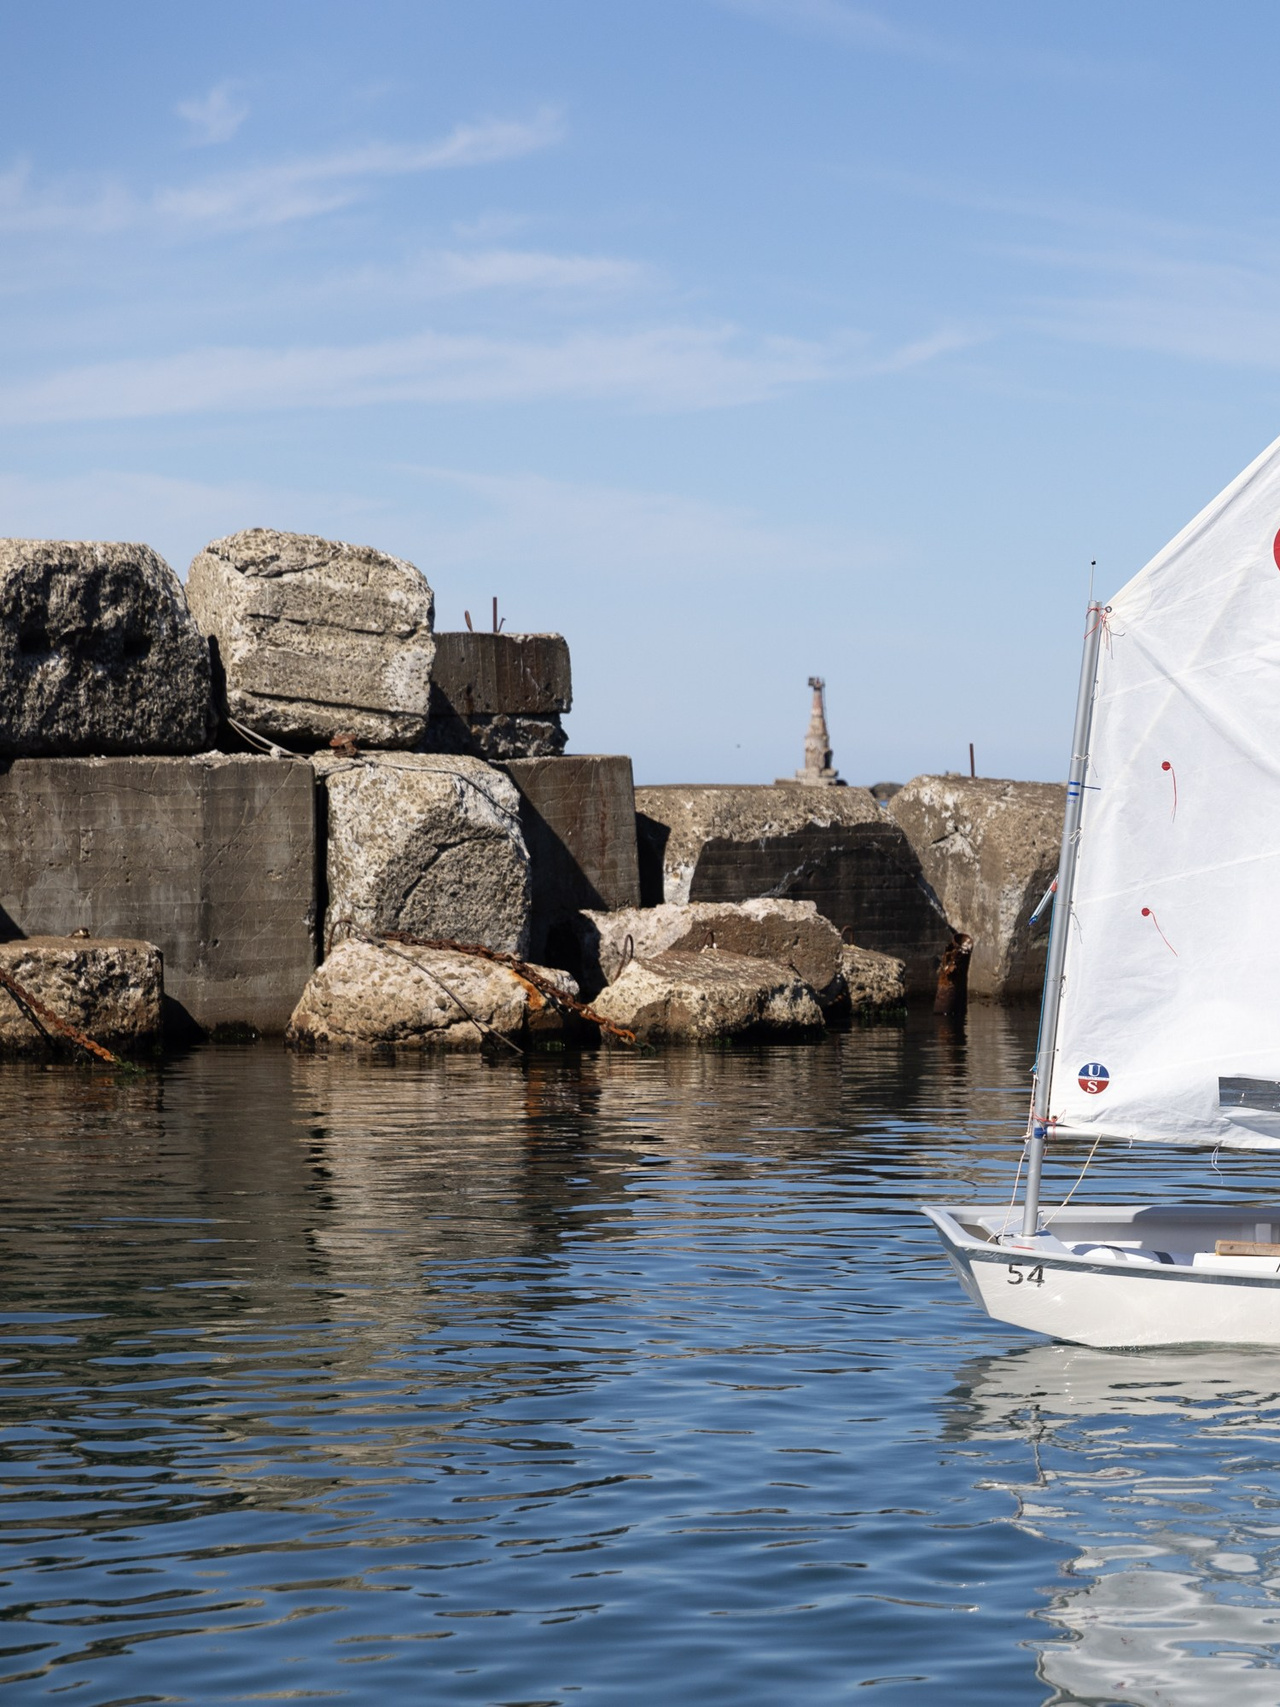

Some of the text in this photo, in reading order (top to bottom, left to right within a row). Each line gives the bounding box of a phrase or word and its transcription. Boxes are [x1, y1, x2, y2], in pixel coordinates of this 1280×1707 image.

[1088, 1064, 1101, 1077] U
[1086, 1080, 1098, 1093] S
[1007, 1263, 1045, 1287] 54
